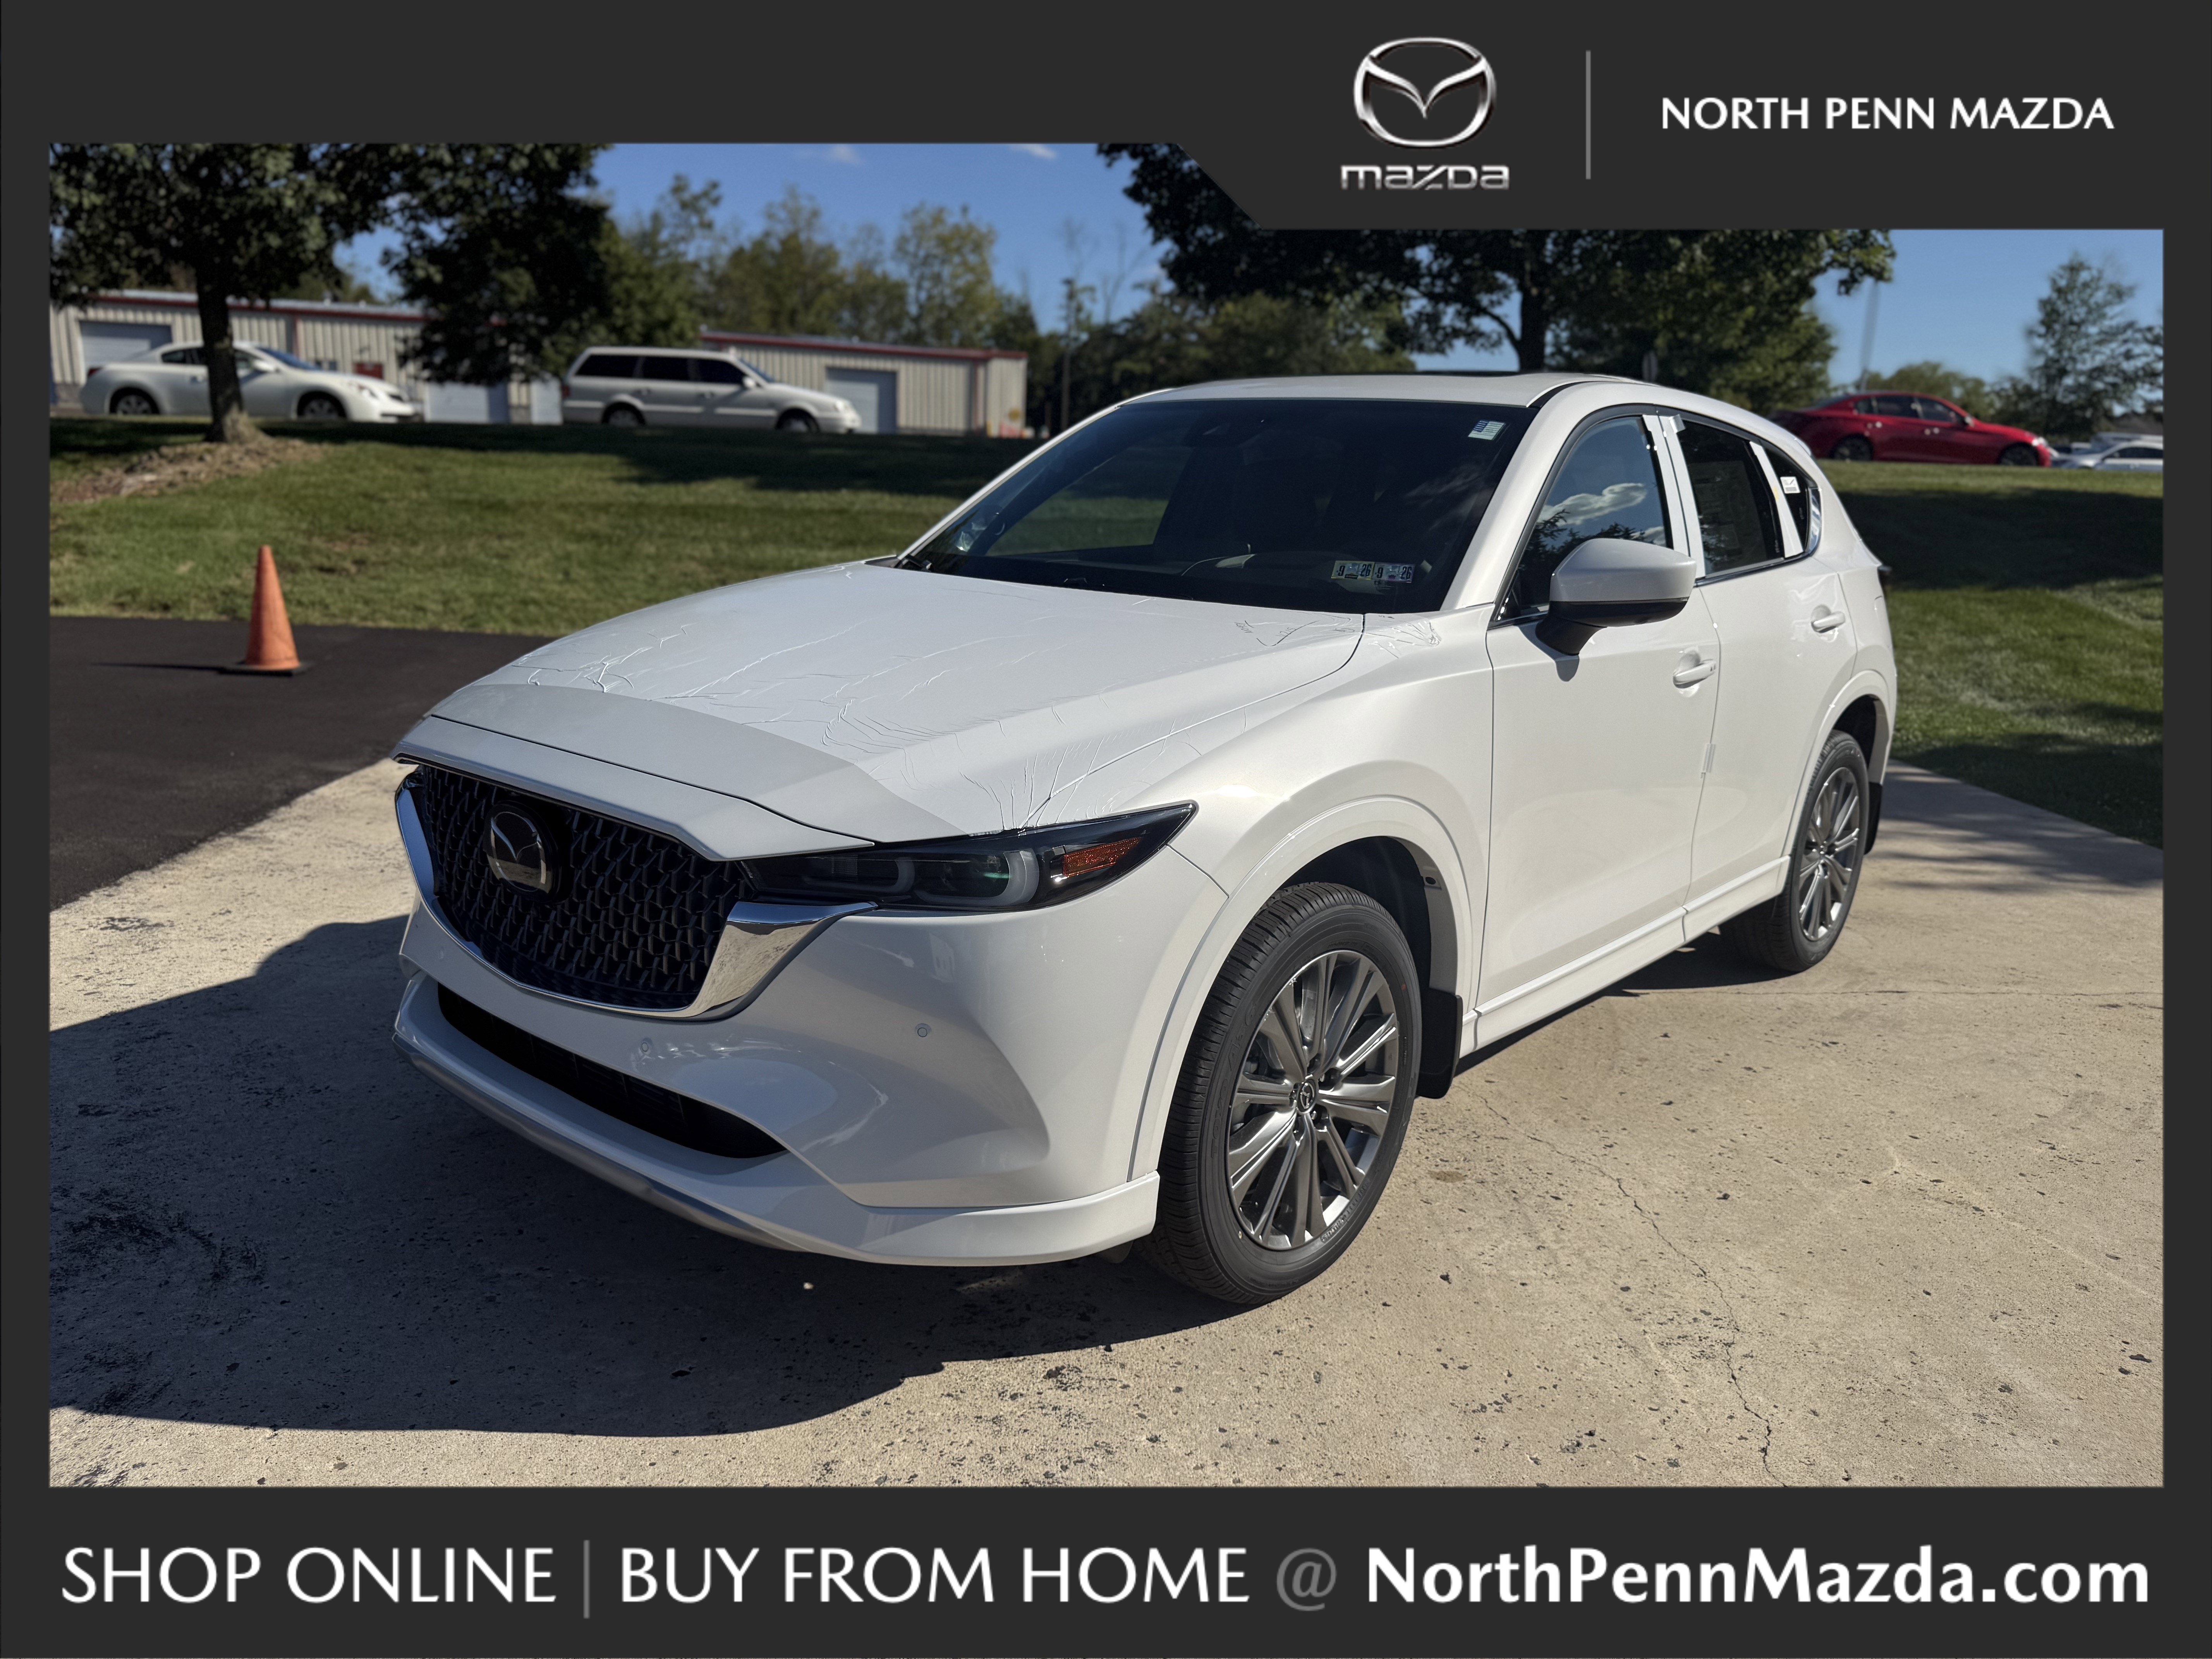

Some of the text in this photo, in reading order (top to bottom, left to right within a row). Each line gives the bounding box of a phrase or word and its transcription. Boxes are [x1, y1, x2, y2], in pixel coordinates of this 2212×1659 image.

[1338, 564, 1372, 577] 9 26
[1377, 566, 1412, 579] 9 26
